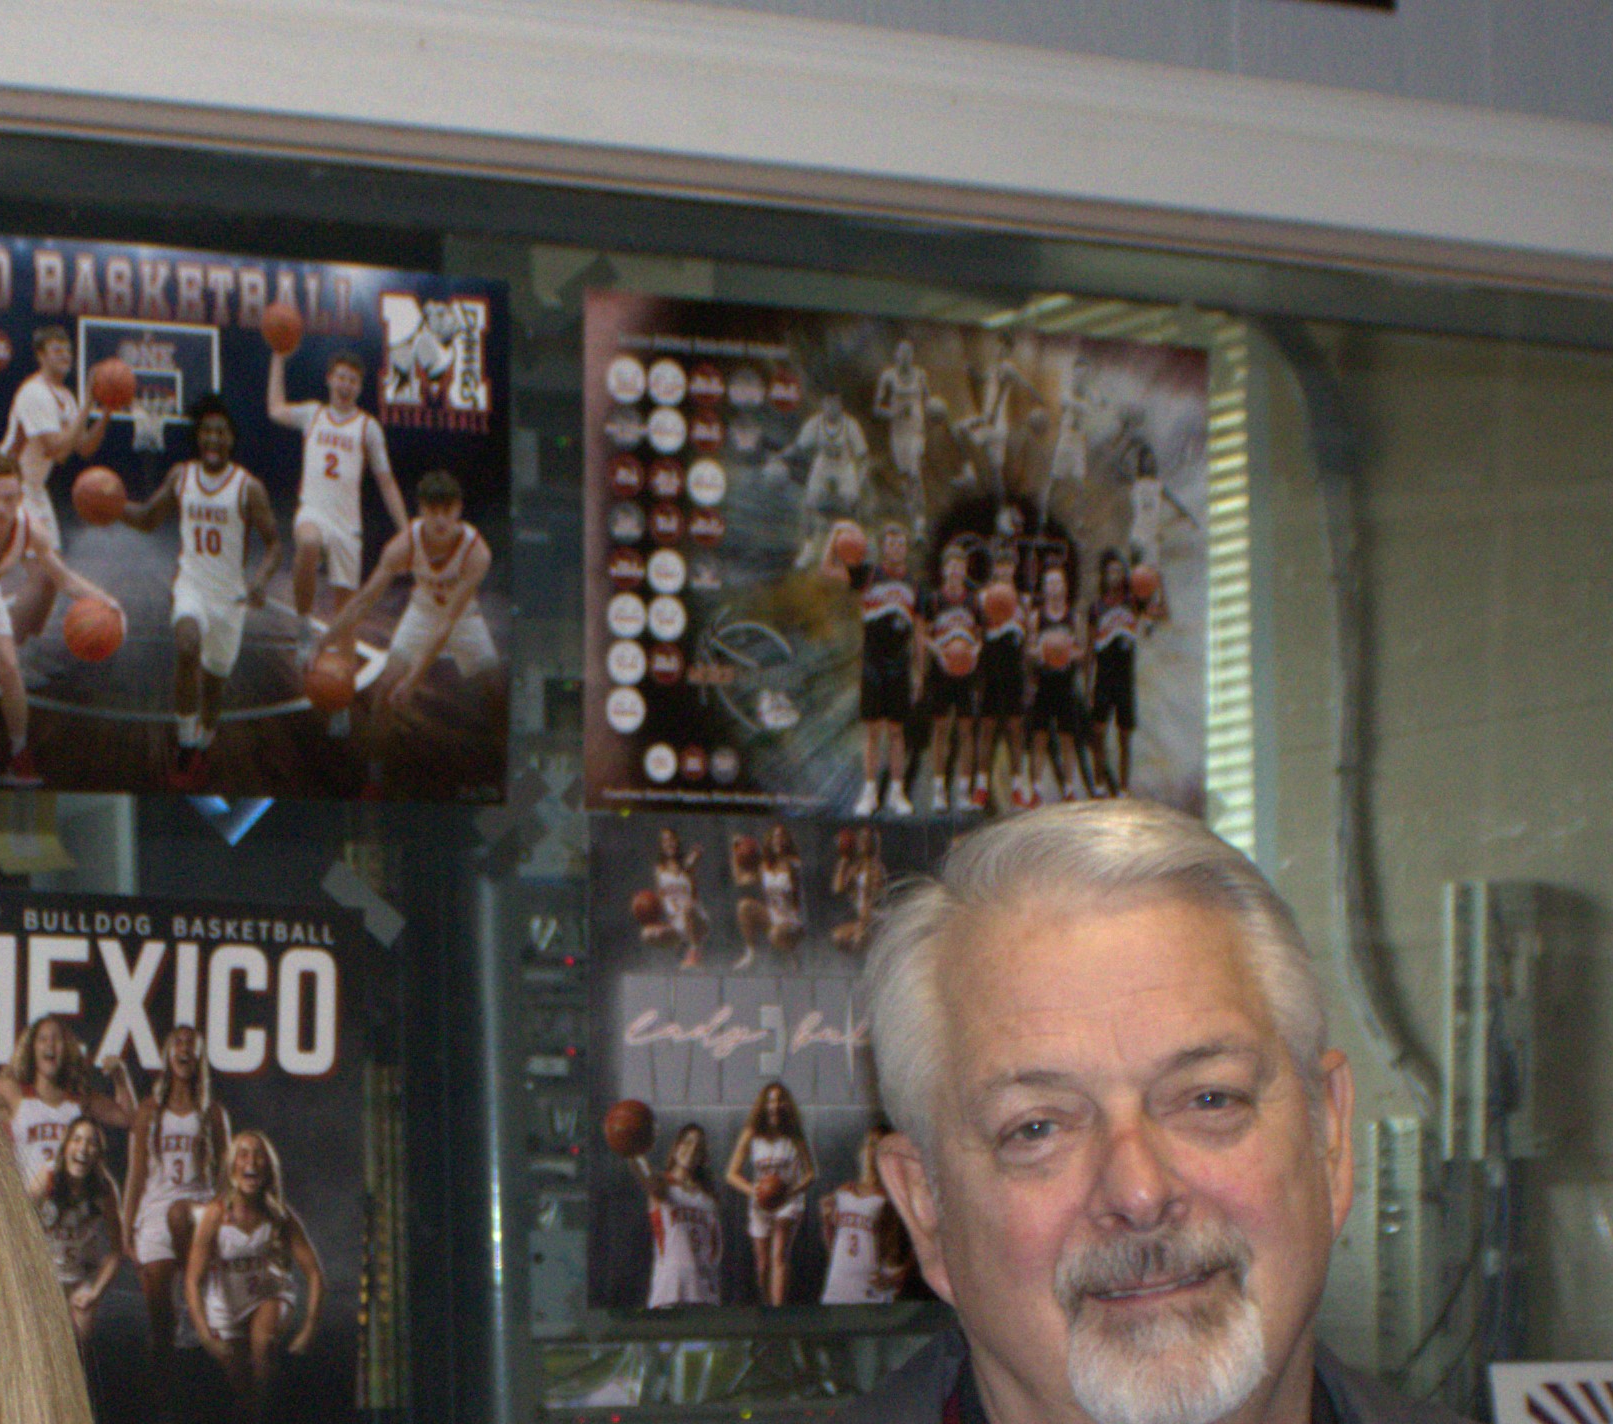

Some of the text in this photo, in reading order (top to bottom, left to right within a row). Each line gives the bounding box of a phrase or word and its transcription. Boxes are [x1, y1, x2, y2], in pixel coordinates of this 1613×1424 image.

[31, 249, 364, 337] BASKETBALL
[324, 452, 341, 480] 2
[193, 525, 223, 558] 10
[22, 909, 152, 937] BULLDOG
[172, 915, 336, 946] BASKETBALL
